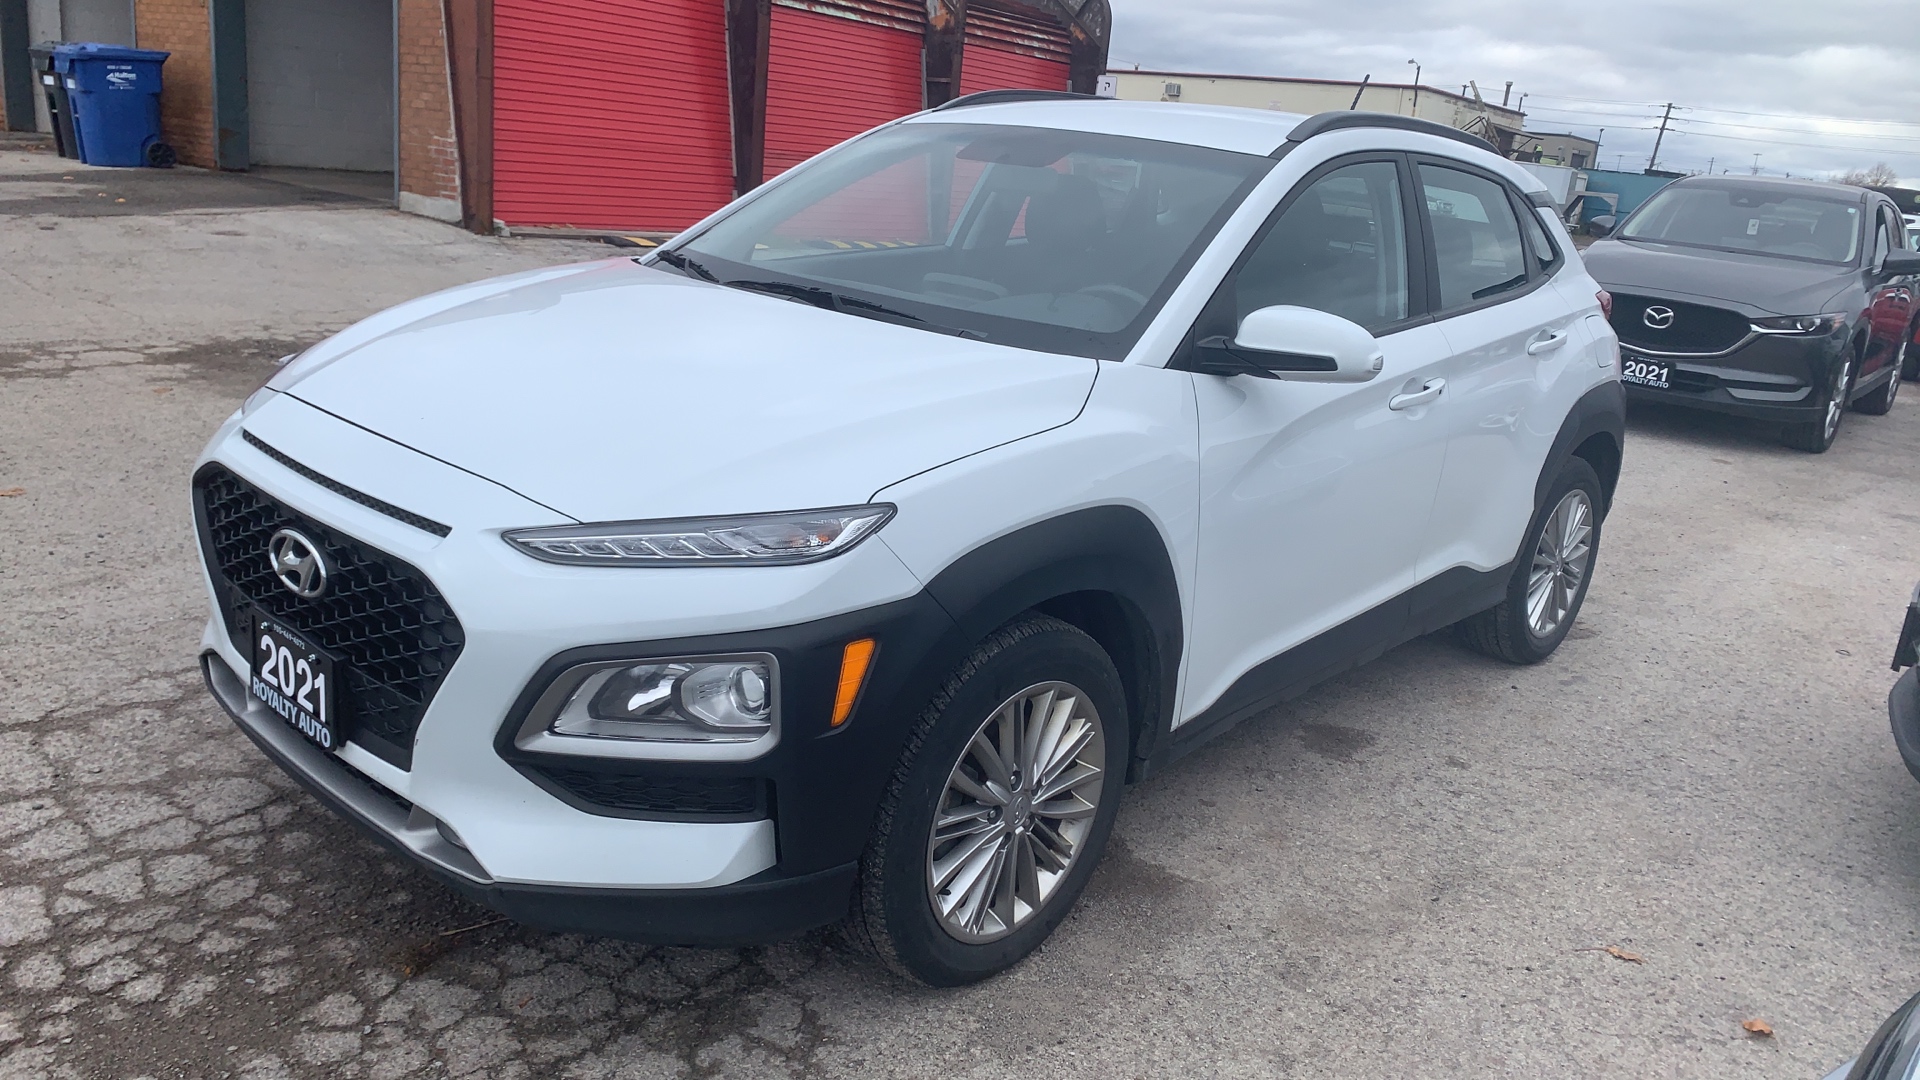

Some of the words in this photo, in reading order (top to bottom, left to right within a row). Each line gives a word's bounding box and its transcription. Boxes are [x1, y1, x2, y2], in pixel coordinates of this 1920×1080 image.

[1623, 361, 1669, 382] 2021
[1648, 379, 1669, 389] AUTO
[260, 634, 326, 723] 2021
[253, 676, 298, 724] ROYALTY
[298, 711, 331, 748] AUTO
